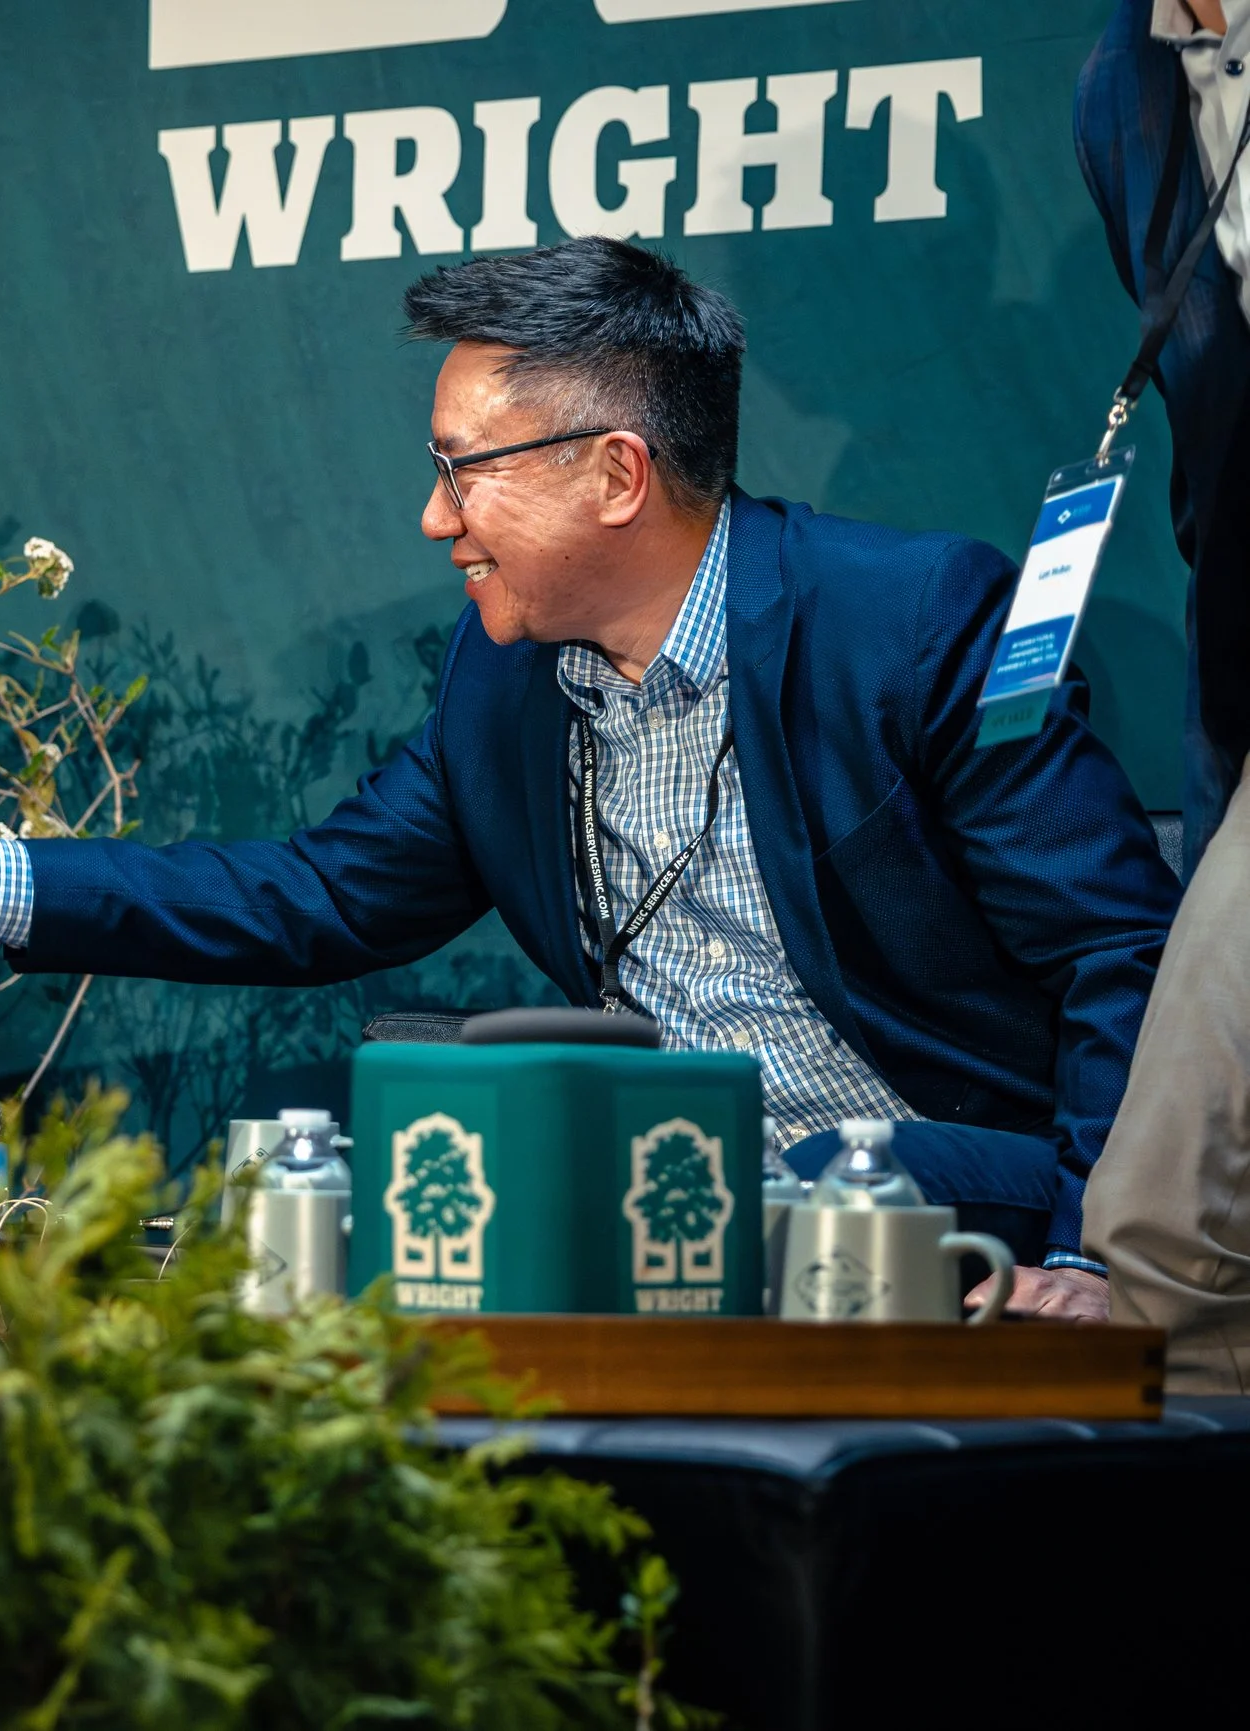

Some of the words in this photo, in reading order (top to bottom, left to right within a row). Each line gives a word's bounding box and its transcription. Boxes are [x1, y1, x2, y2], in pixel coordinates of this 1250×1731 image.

[159, 57, 983, 273] WRIGHT
[584, 747, 593, 766] INC
[584, 769, 610, 919] WWW.INTECSERVICESINC.COM
[626, 909, 648, 935] INTEC
[644, 870, 677, 911] SERVICES,
[673, 851, 690, 870] INC
[395, 1282, 485, 1310] WRIGHT
[634, 1287, 724, 1312] WRIGHT
